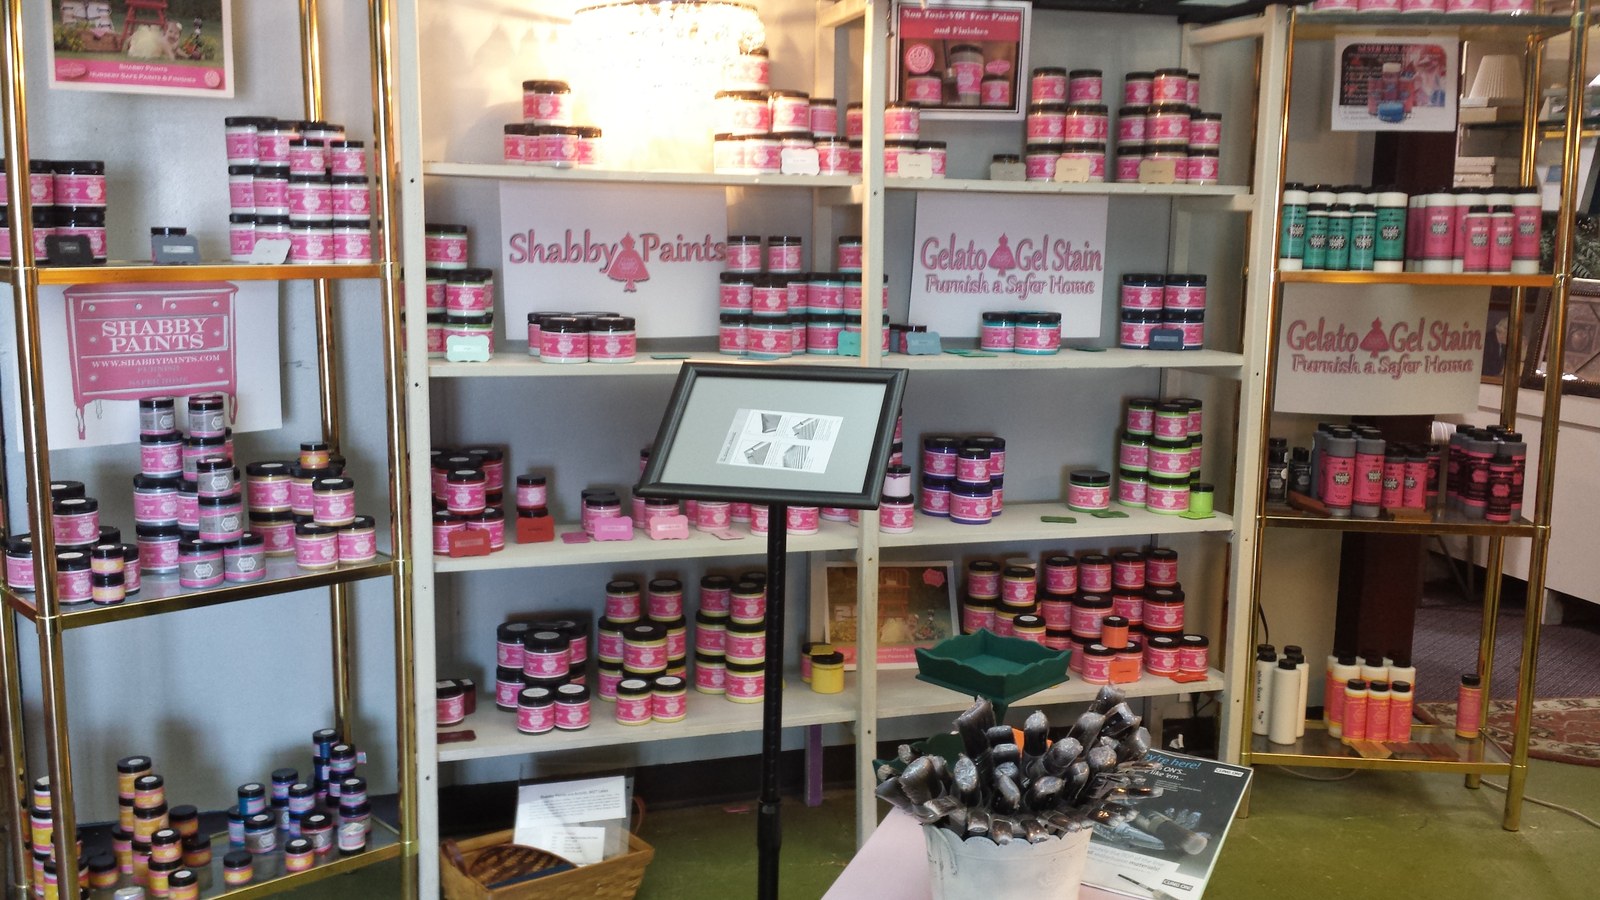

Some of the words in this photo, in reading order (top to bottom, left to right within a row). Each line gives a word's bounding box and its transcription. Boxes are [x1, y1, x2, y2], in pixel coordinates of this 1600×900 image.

[991, 12, 1020, 23] Paints
[933, 25, 950, 35] and
[508, 229, 618, 273] Shabby
[639, 232, 727, 263] Paints
[920, 232, 987, 272] Gelato
[1014, 234, 1049, 271] Gel
[1051, 238, 1103, 272] Stain
[925, 272, 990, 294] Furnish
[992, 281, 1004, 294] a
[1005, 273, 1048, 300] Safer
[1049, 276, 1095, 295] Home
[101, 317, 209, 338] SHABBY
[1286, 316, 1360, 352] Gelato
[1388, 317, 1425, 353] Gel
[1427, 320, 1483, 352] Stain
[109, 333, 205, 353] PAINTS
[92, 354, 220, 368] WWW.SHABBYPAINTS.COM
[1291, 353, 1361, 375] Furnish
[1363, 360, 1376, 375] a
[1378, 354, 1422, 380] Safer
[1424, 355, 1473, 374] Home
[1170, 758, 1202, 770] here!
